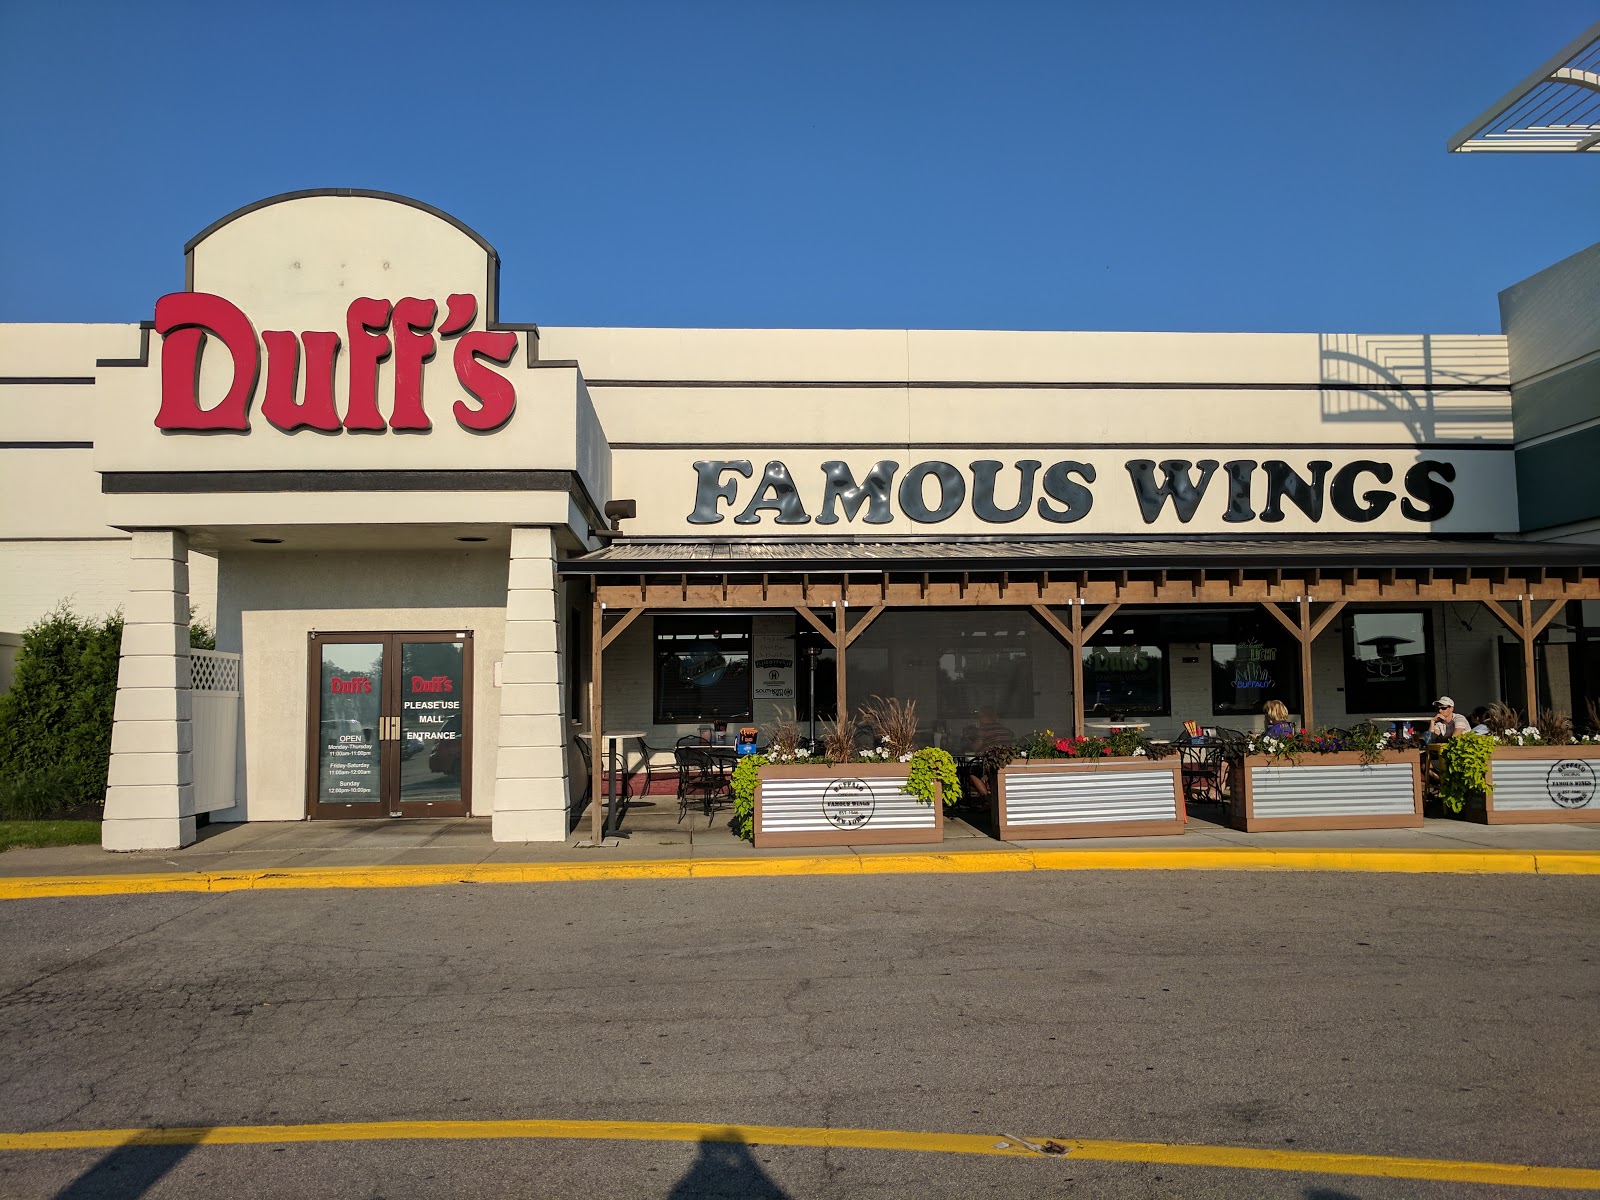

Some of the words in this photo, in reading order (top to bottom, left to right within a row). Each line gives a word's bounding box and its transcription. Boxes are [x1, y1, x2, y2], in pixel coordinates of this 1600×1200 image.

[154, 291, 519, 433] Duff's
[686, 460, 1097, 525] FAMOUS
[1125, 459, 1456, 524] WINGS
[1092, 645, 1149, 671] Duff's
[331, 677, 373, 694] Duff's
[411, 675, 453, 693] Duff's
[404, 701, 440, 709] PLEASE
[441, 701, 460, 709] USE
[419, 715, 444, 723] MALL
[406, 731, 456, 740] ENTRANCE
[1558, 763, 1585, 773] BUFFALO
[833, 781, 864, 792] BUFFALO
